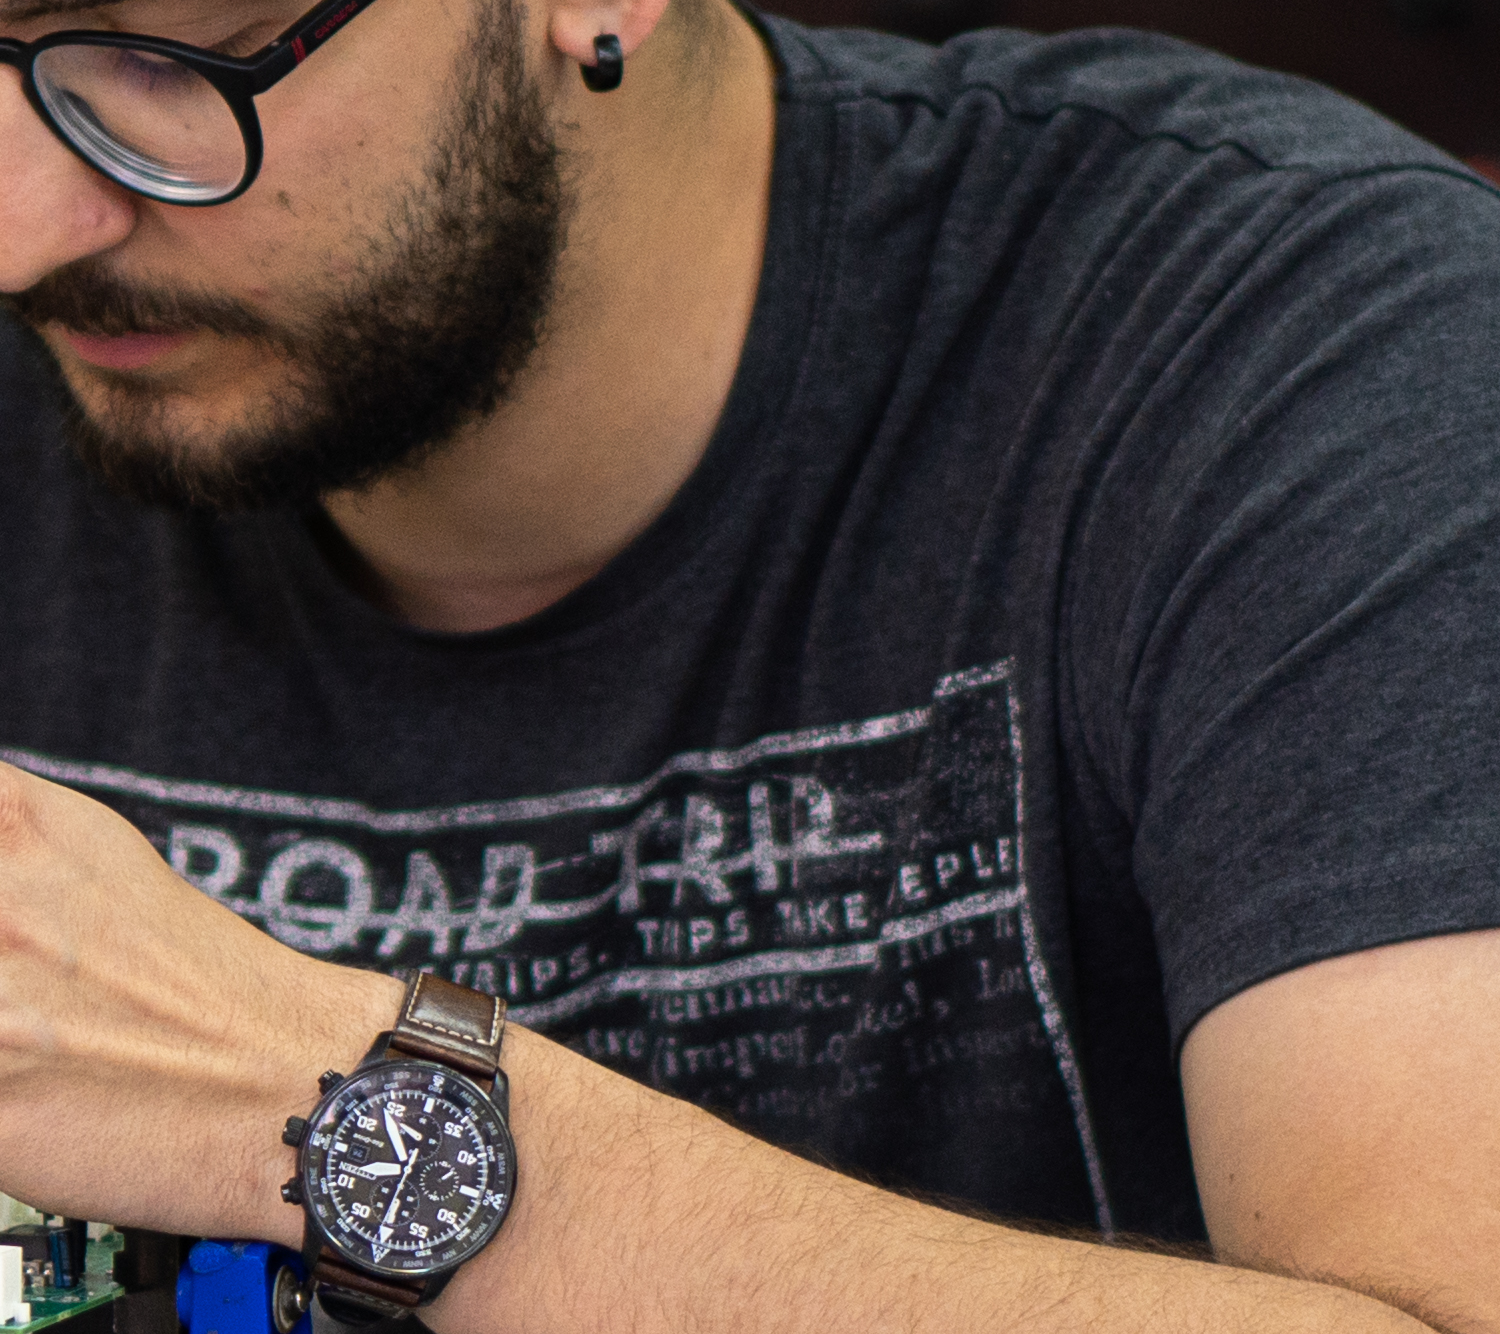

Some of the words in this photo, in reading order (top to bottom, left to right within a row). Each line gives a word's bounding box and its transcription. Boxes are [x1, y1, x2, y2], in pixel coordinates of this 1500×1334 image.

[386, 1101, 406, 1117] 25
[357, 1116, 377, 1131] 20
[444, 1121, 464, 1138] 35
[457, 1150, 478, 1166] 40
[337, 1173, 356, 1189] 10
[351, 1202, 371, 1218] 05
[437, 1208, 457, 1225] 50
[409, 1222, 429, 1239] 55
